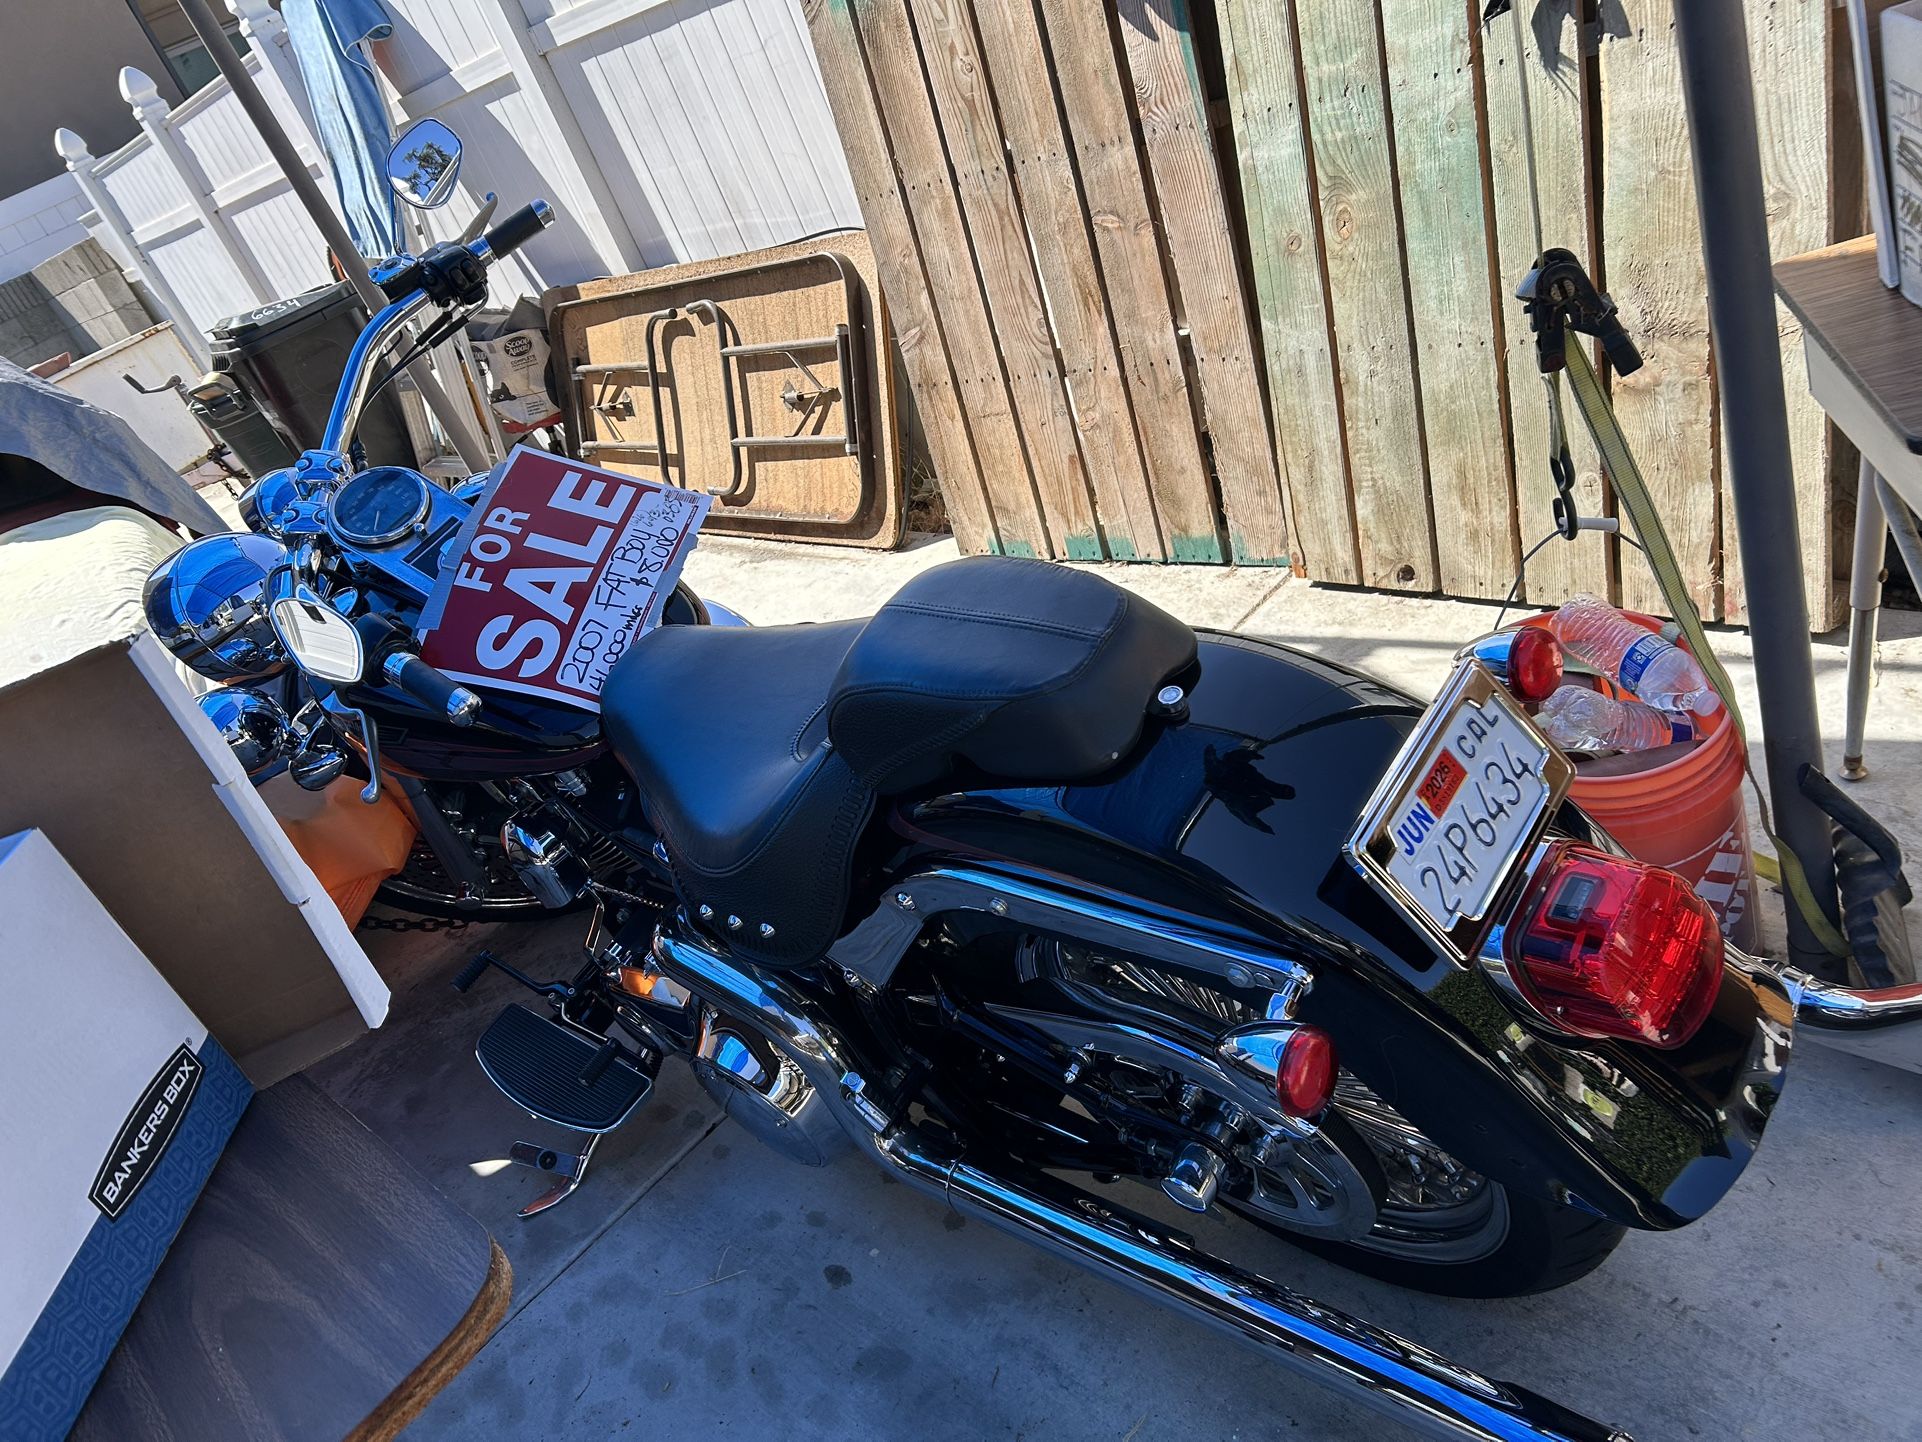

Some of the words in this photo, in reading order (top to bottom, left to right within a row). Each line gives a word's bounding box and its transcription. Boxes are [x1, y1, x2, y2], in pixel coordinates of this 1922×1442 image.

[251, 298, 301, 320] 6634
[453, 506, 531, 592] FOR
[475, 469, 638, 678] SALE
[561, 618, 609, 684] 2007
[595, 562, 631, 611] FAT
[1456, 708, 1500, 760] CAL
[1425, 761, 1451, 798] 2026
[1396, 802, 1436, 857] JUN
[1420, 742, 1535, 915] 24P6434
[102, 1099, 169, 1204] BANKERS
[162, 1058, 196, 1106] BOX
